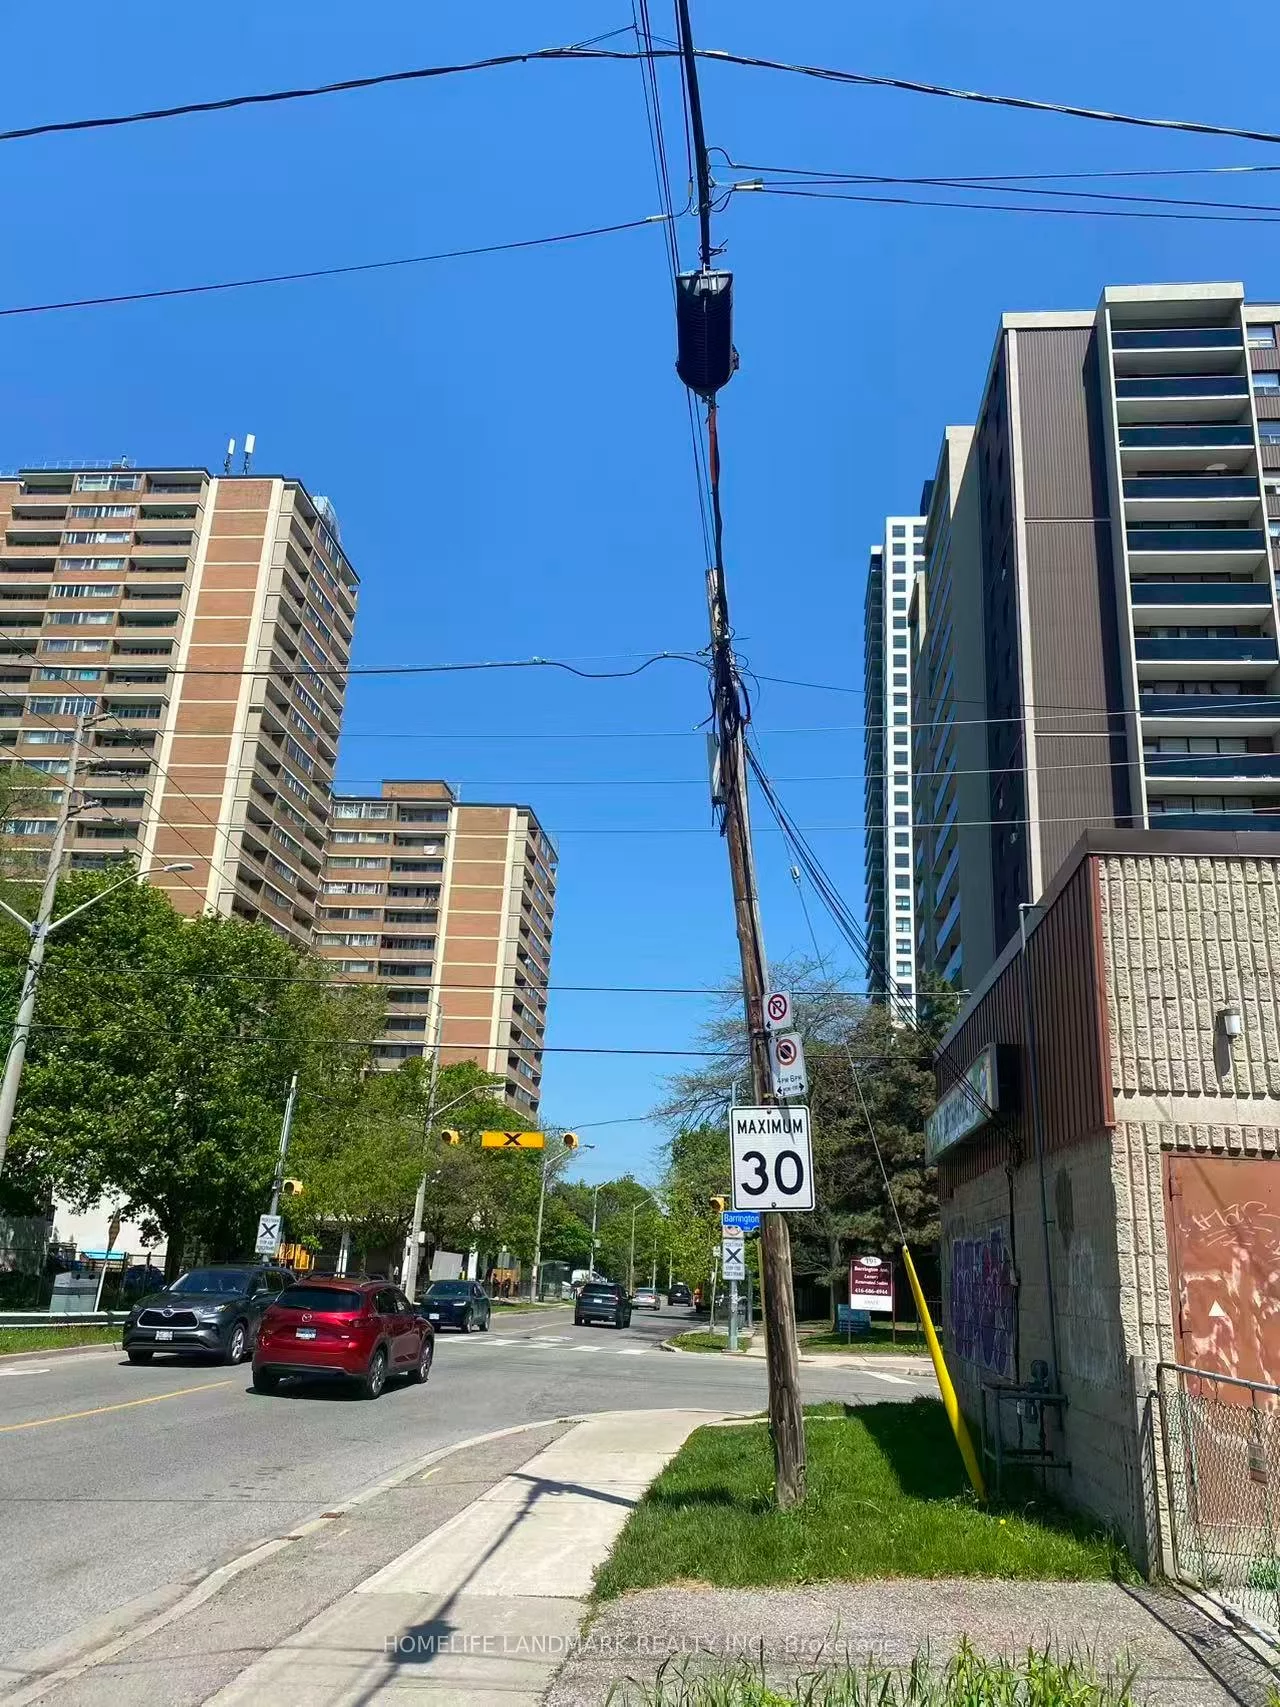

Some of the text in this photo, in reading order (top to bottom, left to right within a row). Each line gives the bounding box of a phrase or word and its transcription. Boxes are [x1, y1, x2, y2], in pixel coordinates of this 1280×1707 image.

[737, 1119, 803, 1134] MAXIMUM
[741, 1150, 804, 1196] 30
[723, 1213, 760, 1225] Barrington
